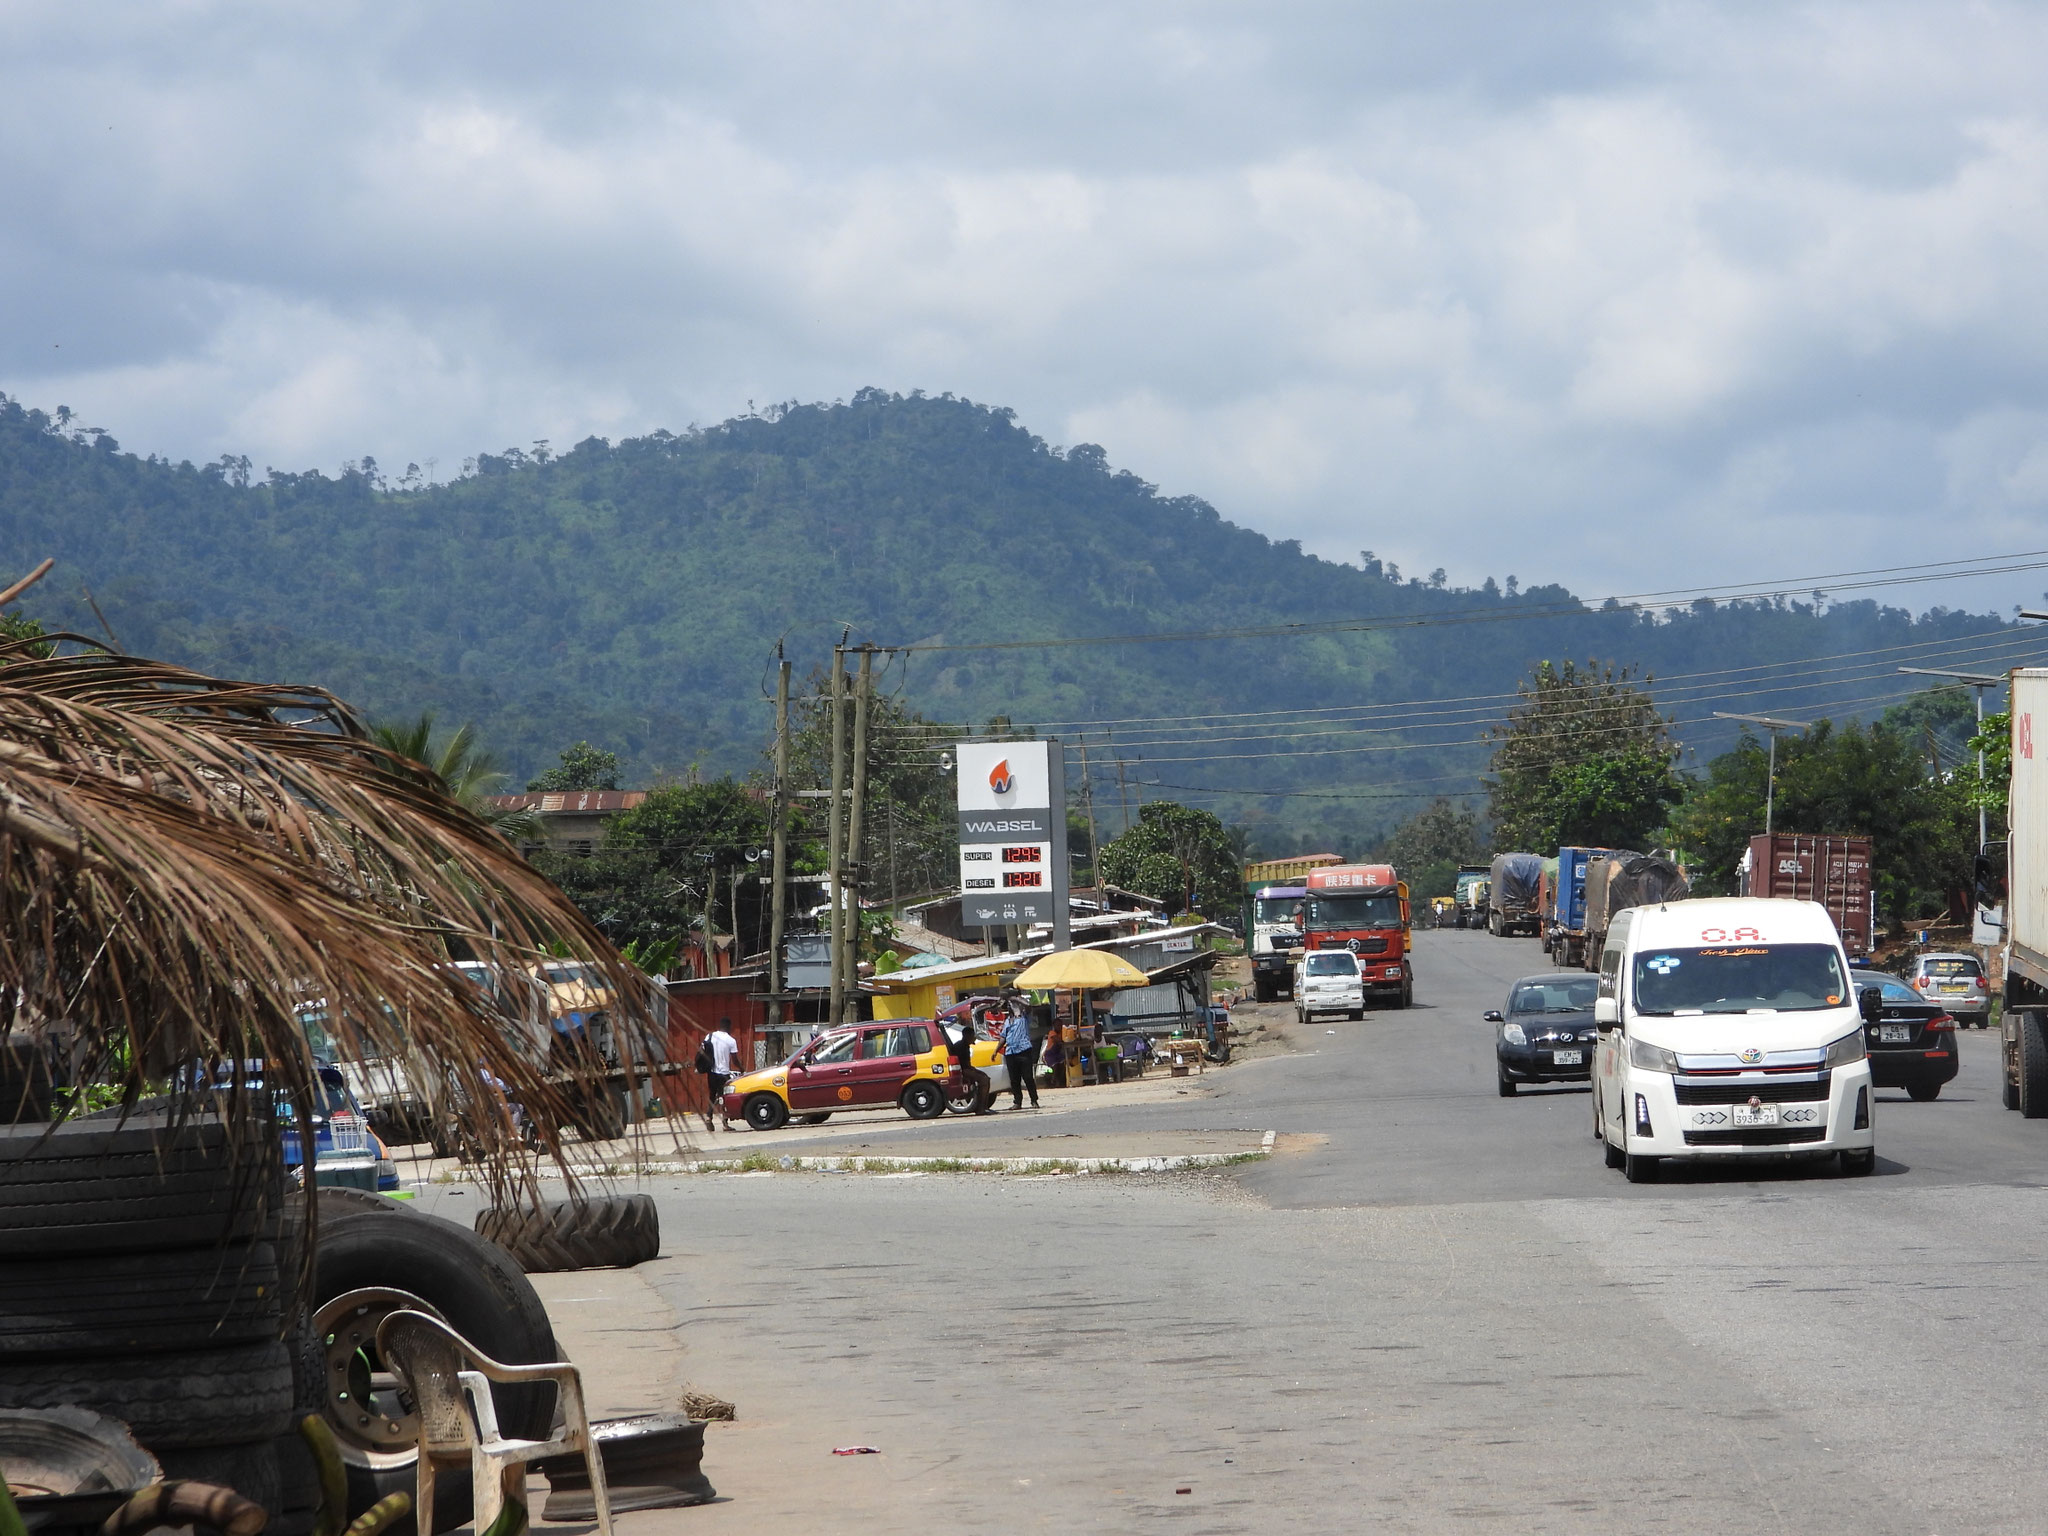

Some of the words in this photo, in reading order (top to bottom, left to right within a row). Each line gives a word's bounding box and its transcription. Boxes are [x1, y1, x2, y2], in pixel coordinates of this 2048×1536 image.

[965, 820, 1043, 833] WABSEL
[964, 852, 992, 860] SUPER
[1006, 847, 1041, 862] 12.95
[966, 879, 994, 887] DIESEL
[1008, 872, 1042, 887] 13.20
[1701, 927, 1767, 943] O.A.
